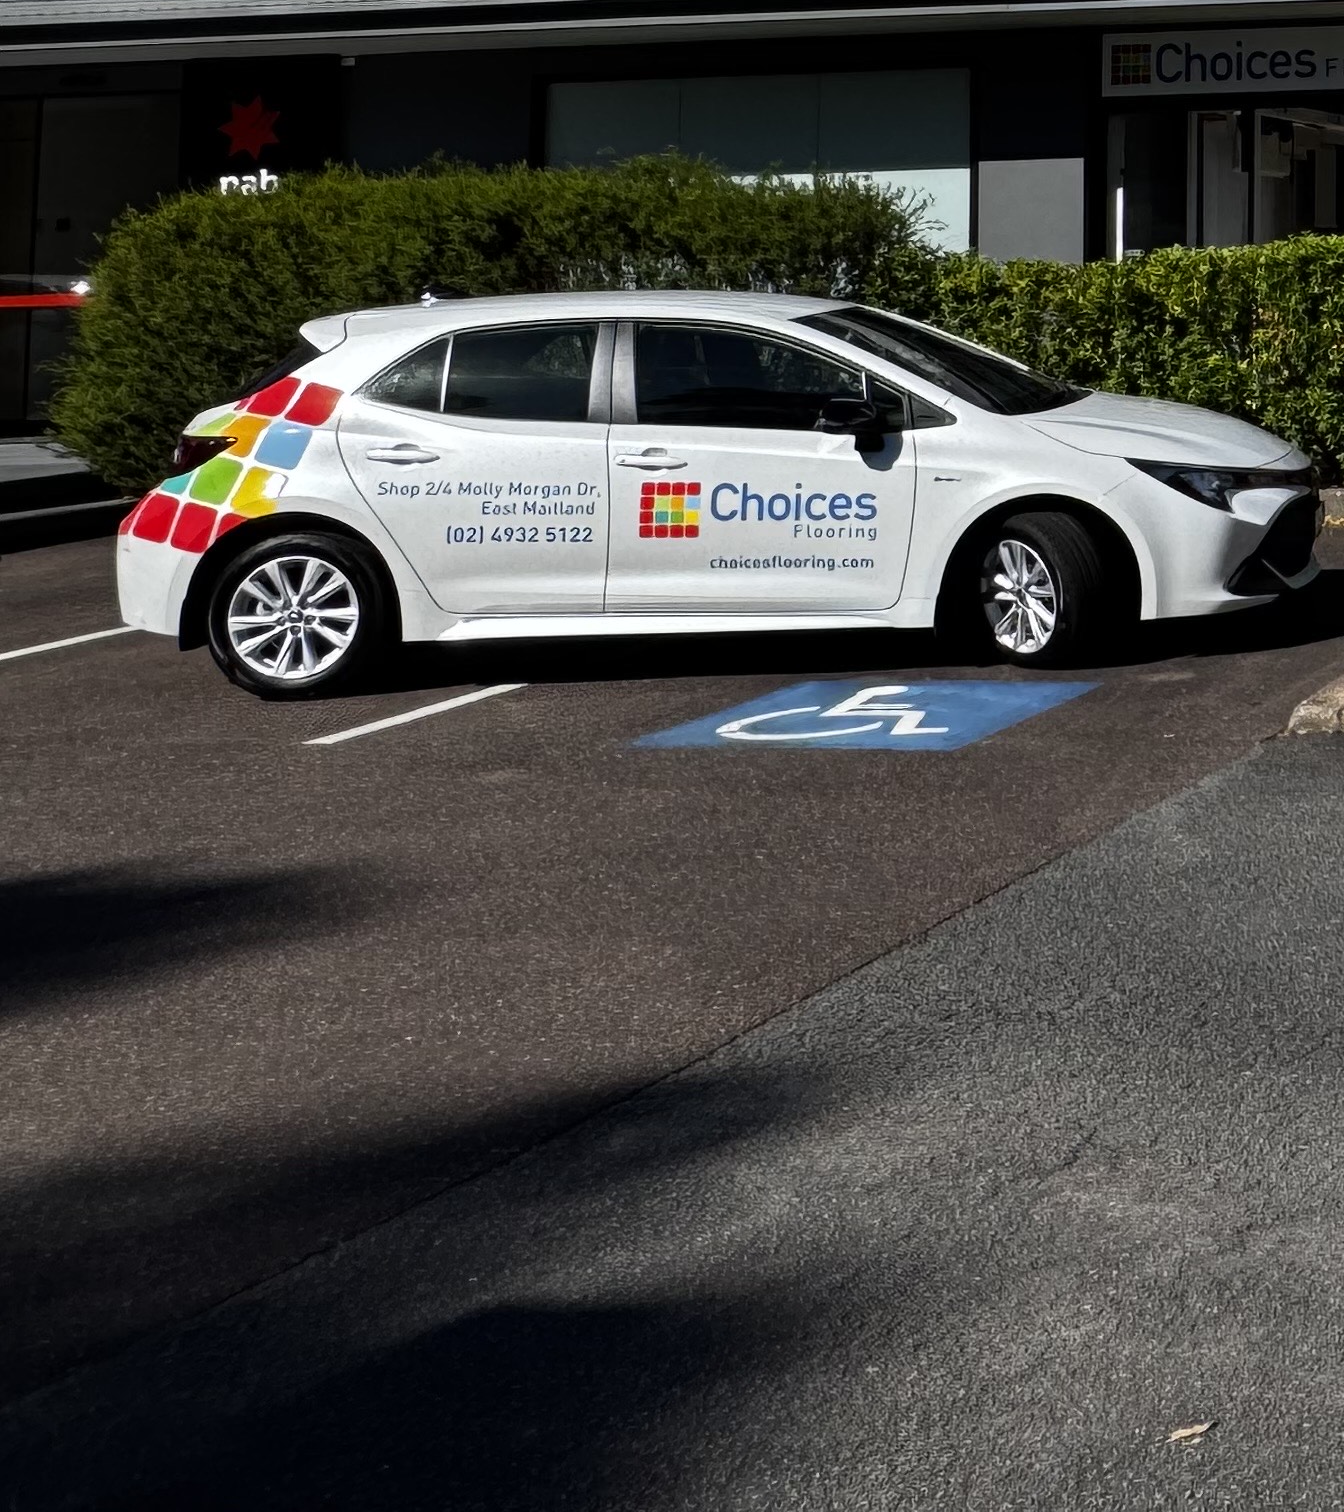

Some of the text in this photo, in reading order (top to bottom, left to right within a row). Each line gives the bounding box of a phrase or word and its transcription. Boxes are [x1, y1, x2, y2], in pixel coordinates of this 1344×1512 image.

[1155, 41, 1317, 84] Choices
[377, 481, 420, 498] Shop
[425, 480, 452, 496] 2/4
[457, 481, 503, 499] Molly
[508, 481, 572, 499] Morgan
[481, 501, 517, 516] East
[710, 482, 878, 522] Choices
[446, 525, 594, 544] (02) 4932 5122
[793, 524, 878, 541] Flooring
[709, 554, 875, 571] choicesflooring.com
